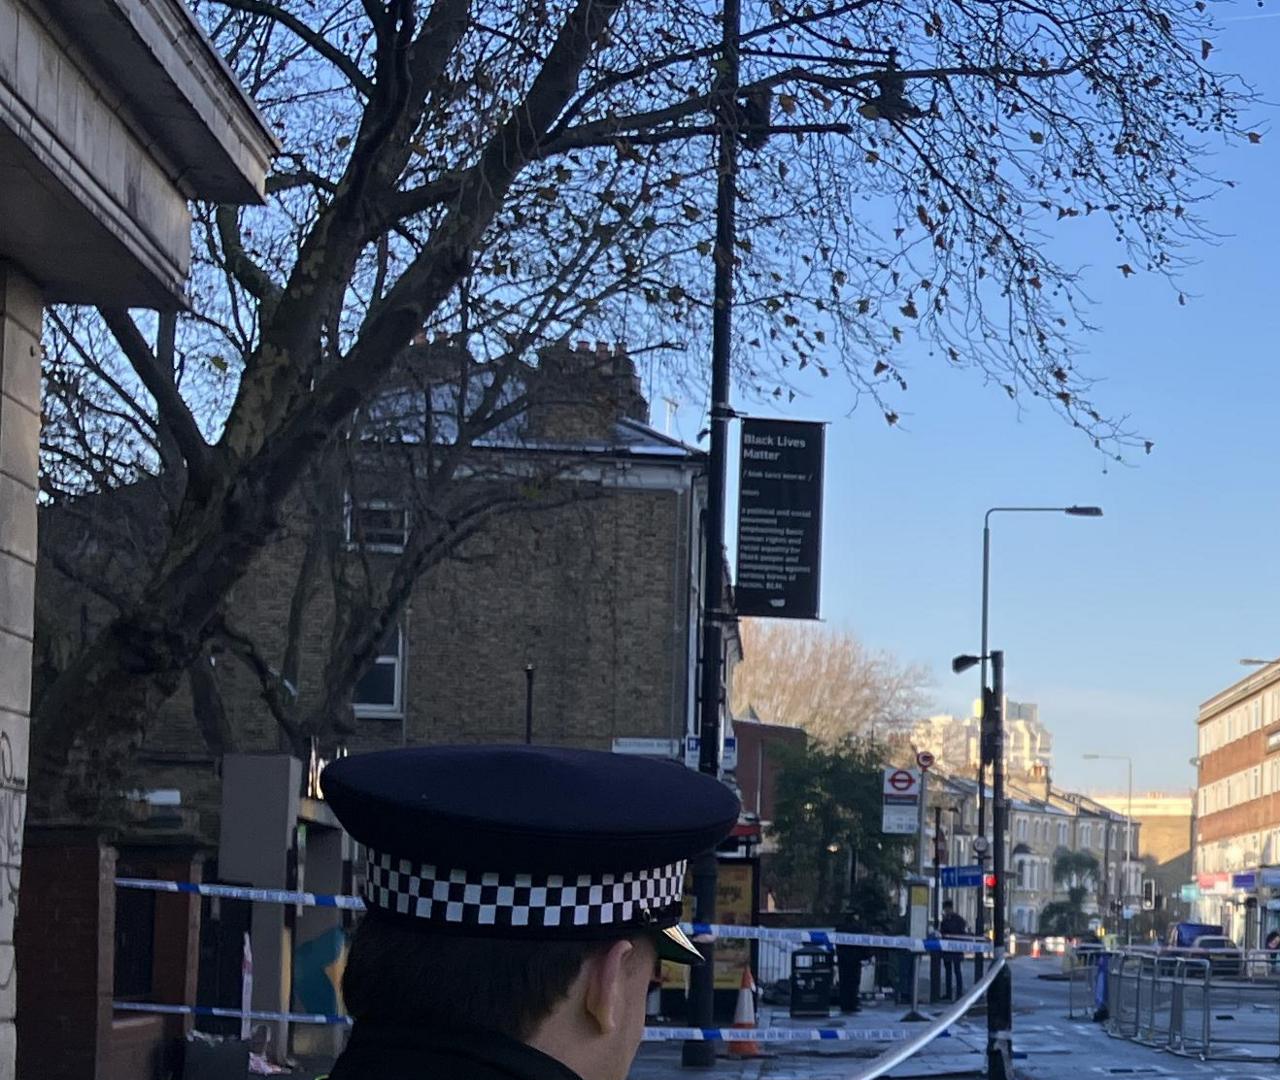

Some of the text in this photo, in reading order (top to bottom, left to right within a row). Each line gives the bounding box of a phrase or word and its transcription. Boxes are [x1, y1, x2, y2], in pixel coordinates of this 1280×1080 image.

[743, 434, 806, 448] Black Lives
[743, 448, 781, 461] Matter
